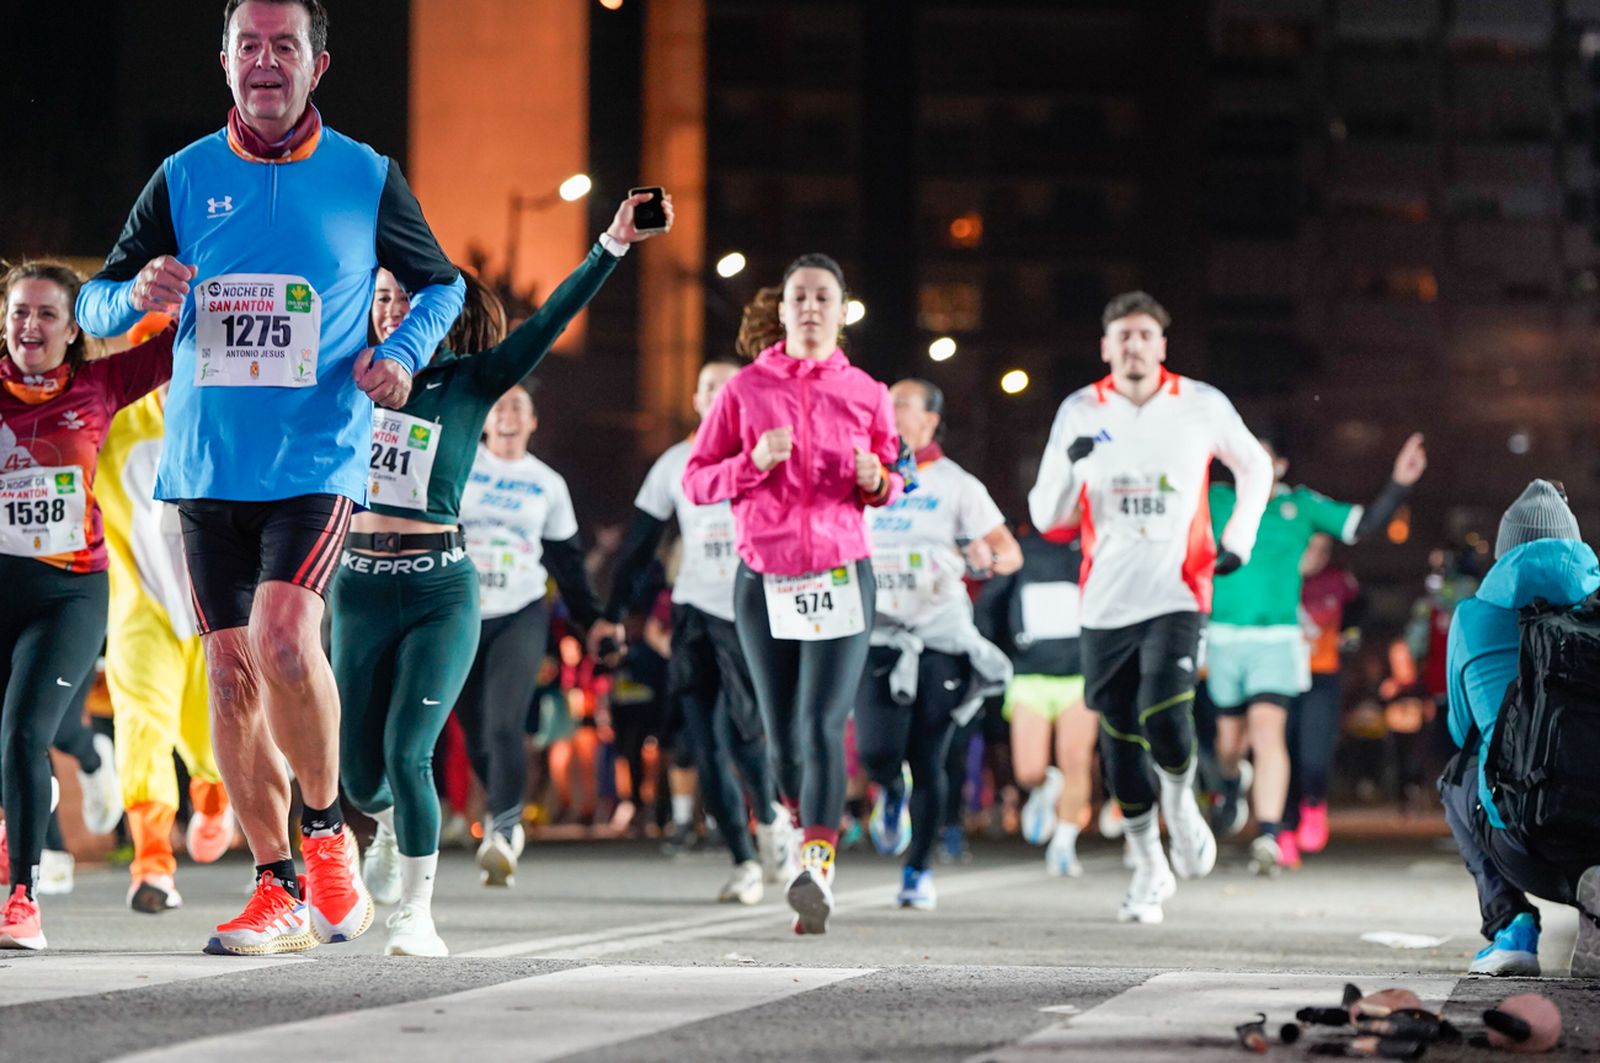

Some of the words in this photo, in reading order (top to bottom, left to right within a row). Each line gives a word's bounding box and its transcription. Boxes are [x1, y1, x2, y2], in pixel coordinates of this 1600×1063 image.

[222, 286, 258, 297] NOCHE
[260, 286, 275, 297] DE
[209, 301, 231, 312] SAN
[233, 297, 274, 312] ANTÓN
[221, 315, 292, 348] 1275
[226, 349, 259, 359] ANTONIO
[260, 349, 286, 359] JESUS
[0, 490, 15, 498] AN
[4, 498, 65, 526] 1538
[373, 556, 435, 575] PRO
[795, 591, 834, 616] 574
